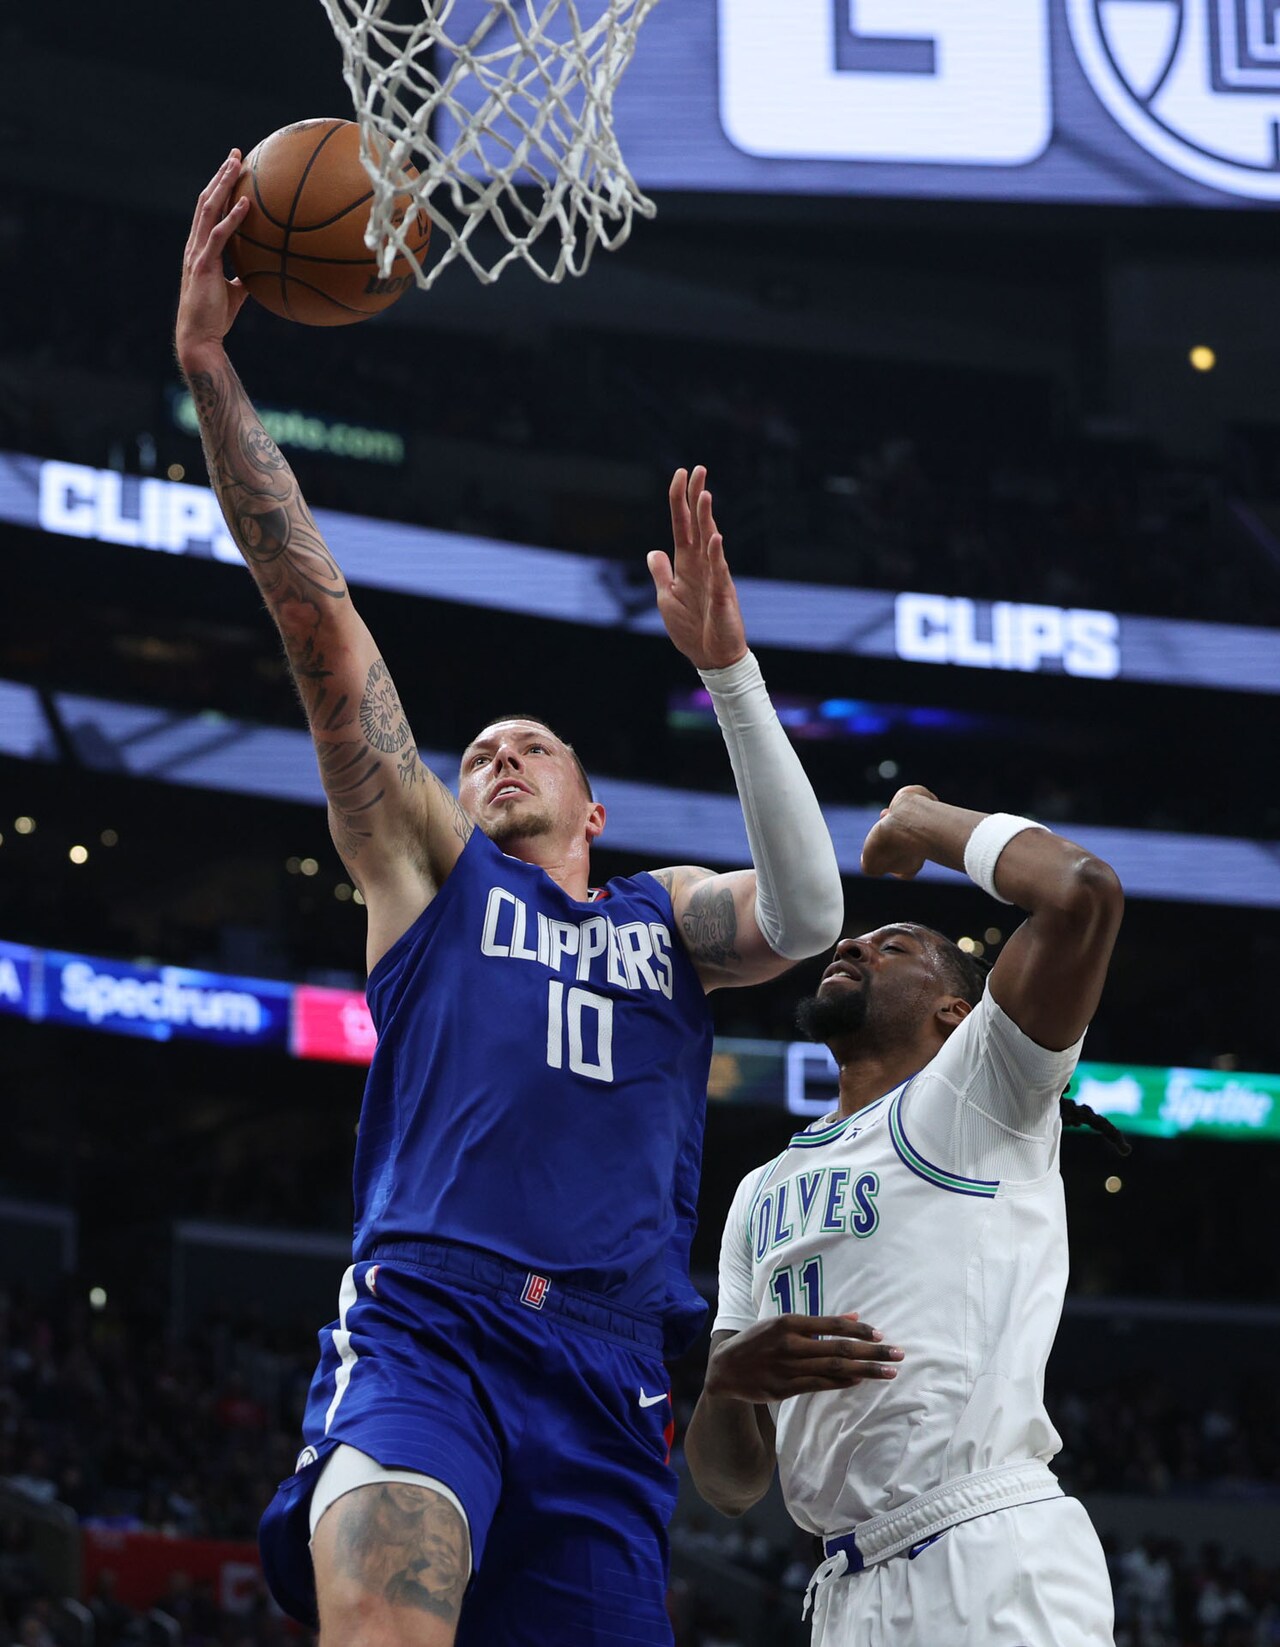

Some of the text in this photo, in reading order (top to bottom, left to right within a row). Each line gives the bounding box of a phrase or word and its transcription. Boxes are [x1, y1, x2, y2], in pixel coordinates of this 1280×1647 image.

[895, 591, 1119, 679] CLIPS
[480, 886, 673, 1001] CLIPPERS
[61, 962, 261, 1034] Spectrum
[547, 979, 613, 1083] 10
[755, 1167, 880, 1264] OLVES
[769, 1254, 824, 1340] 11
